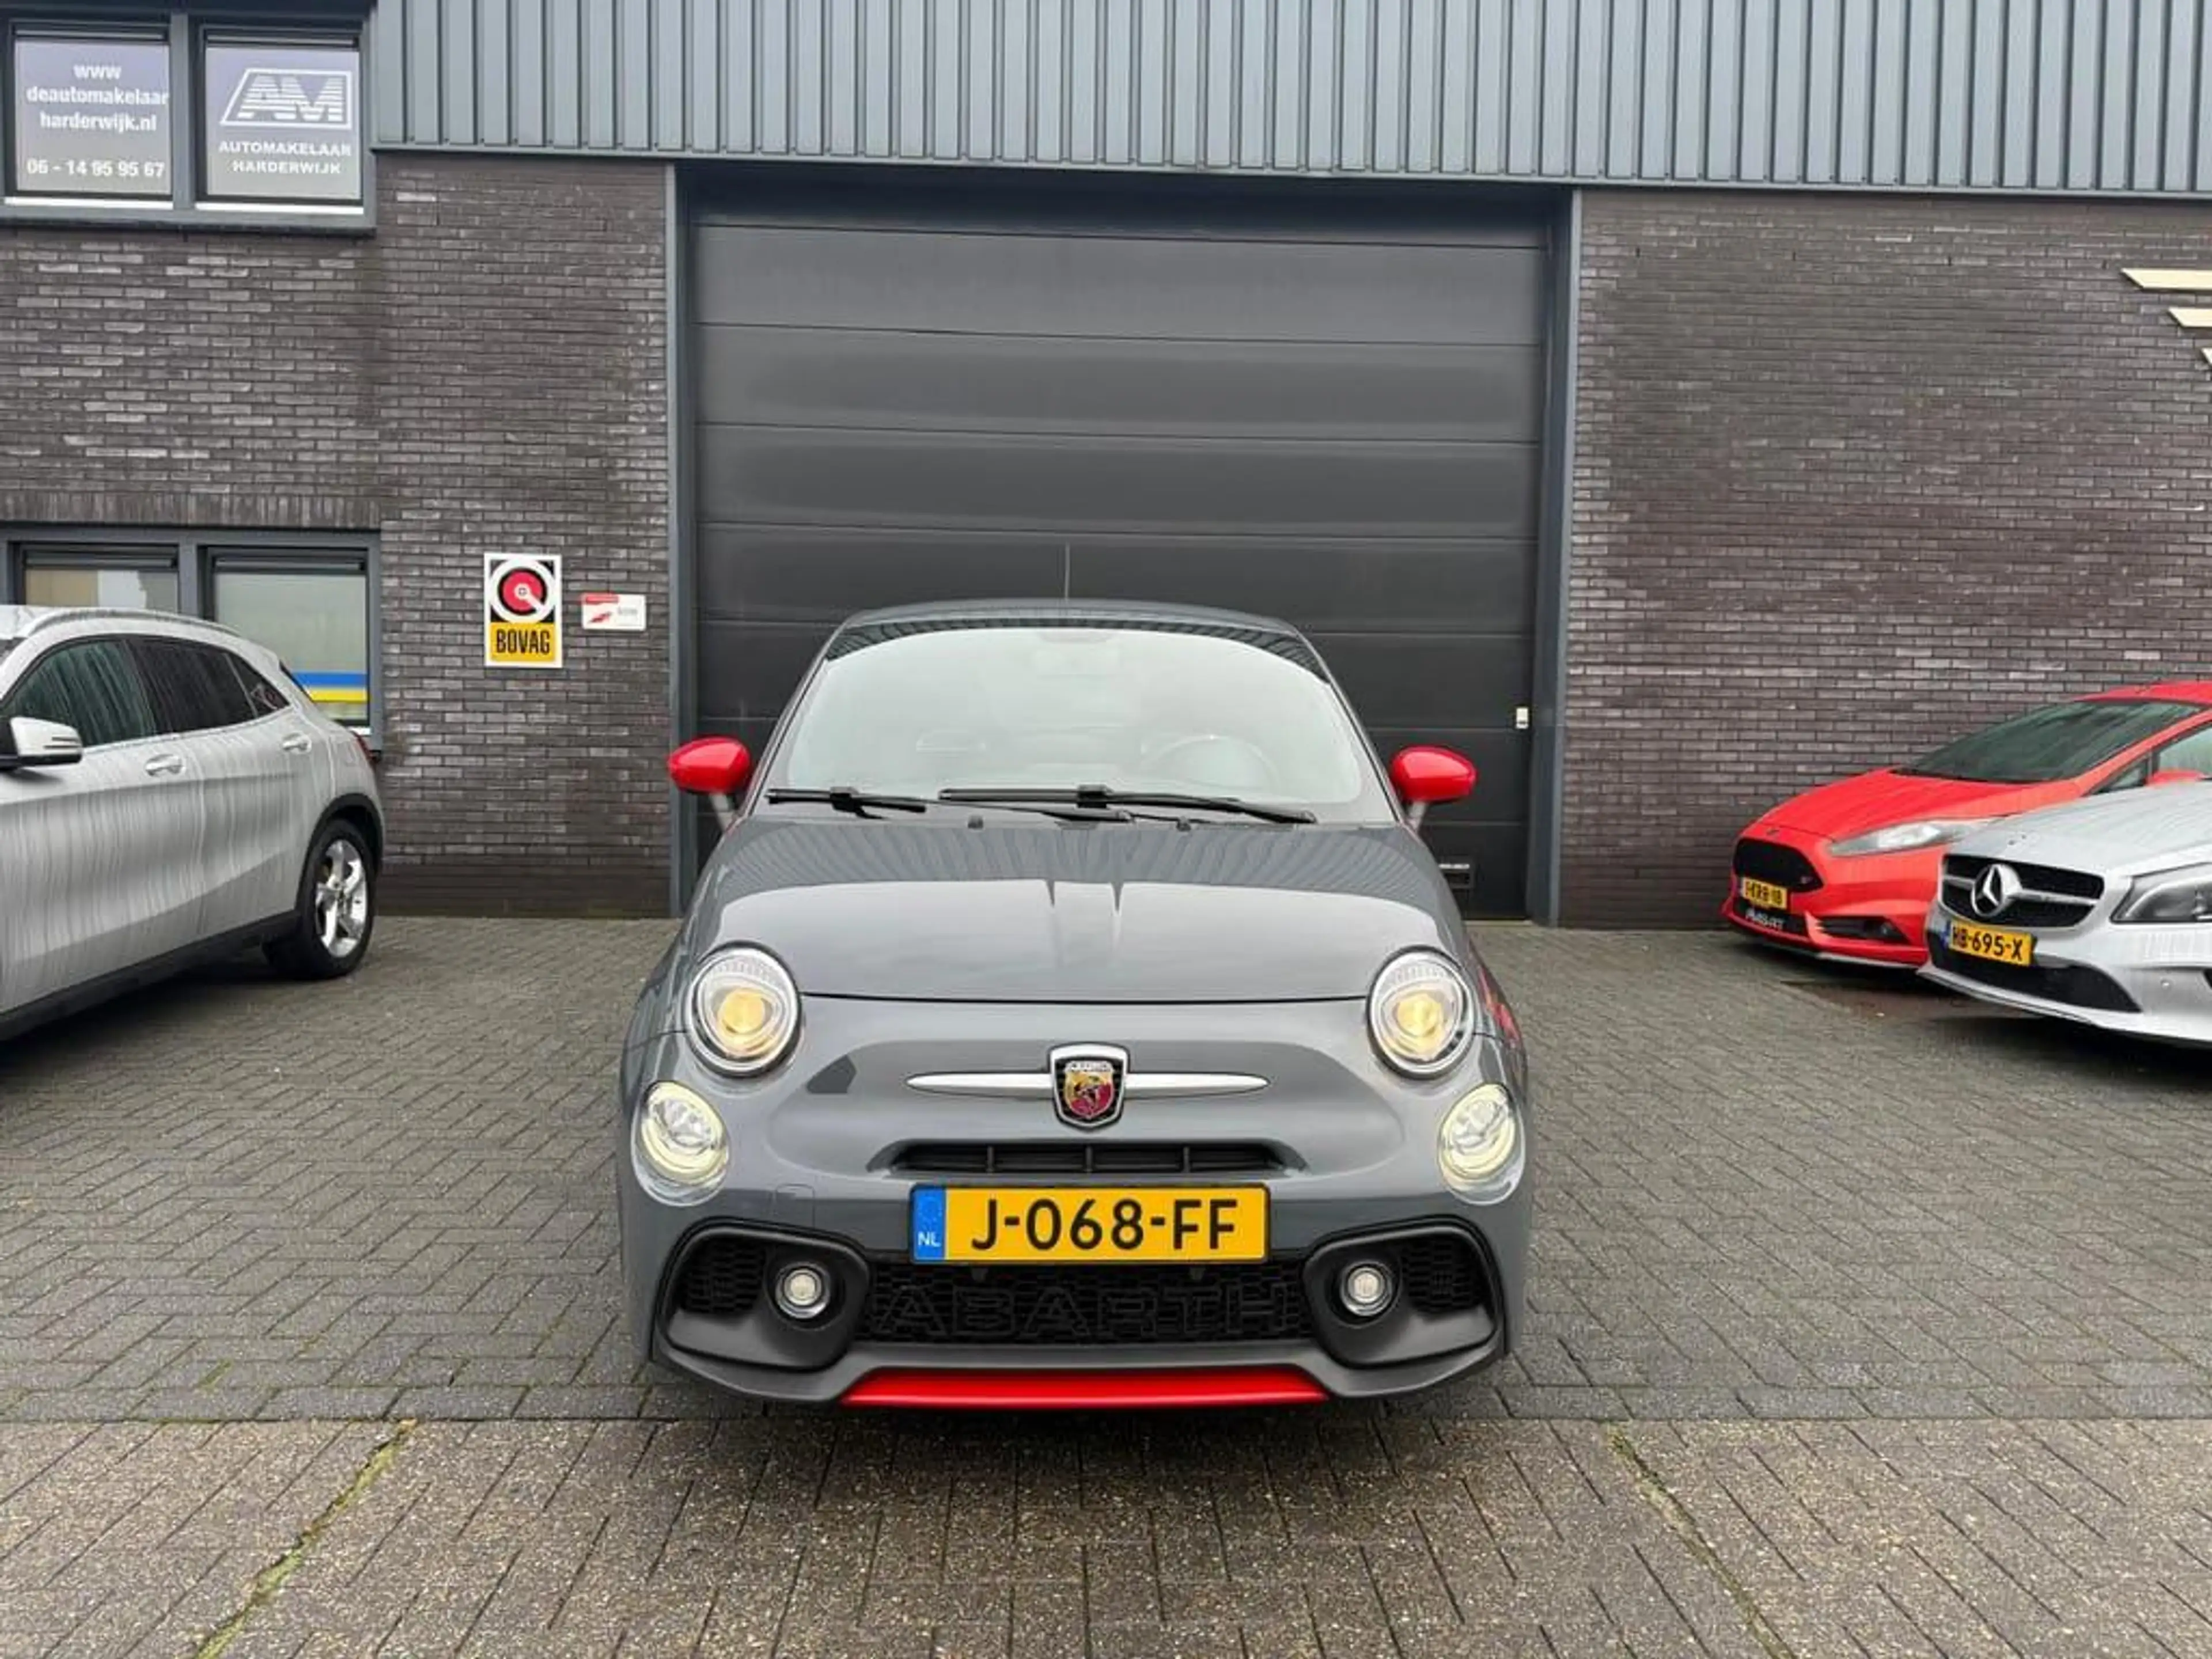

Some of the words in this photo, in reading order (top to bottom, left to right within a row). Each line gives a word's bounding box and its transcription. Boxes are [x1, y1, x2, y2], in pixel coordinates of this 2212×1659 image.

[73, 66, 122, 79] www
[26, 86, 169, 105] deautomakelaar
[237, 75, 344, 121] AM
[40, 111, 157, 132] harderwijk.nl
[218, 141, 351, 156] AUTOMAKELAAR
[27, 158, 48, 173] 06
[66, 160, 87, 175] 14
[118, 161, 139, 176] 95
[144, 162, 165, 177] 67
[232, 160, 341, 174] HARDERWIJK
[497, 628, 550, 655] BOVAG
[1952, 926, 2023, 962] HB-695-X
[918, 1231, 942, 1248] NL
[971, 1198, 1238, 1251] J-068-FF
[876, 1283, 1290, 1339] ABARTH
